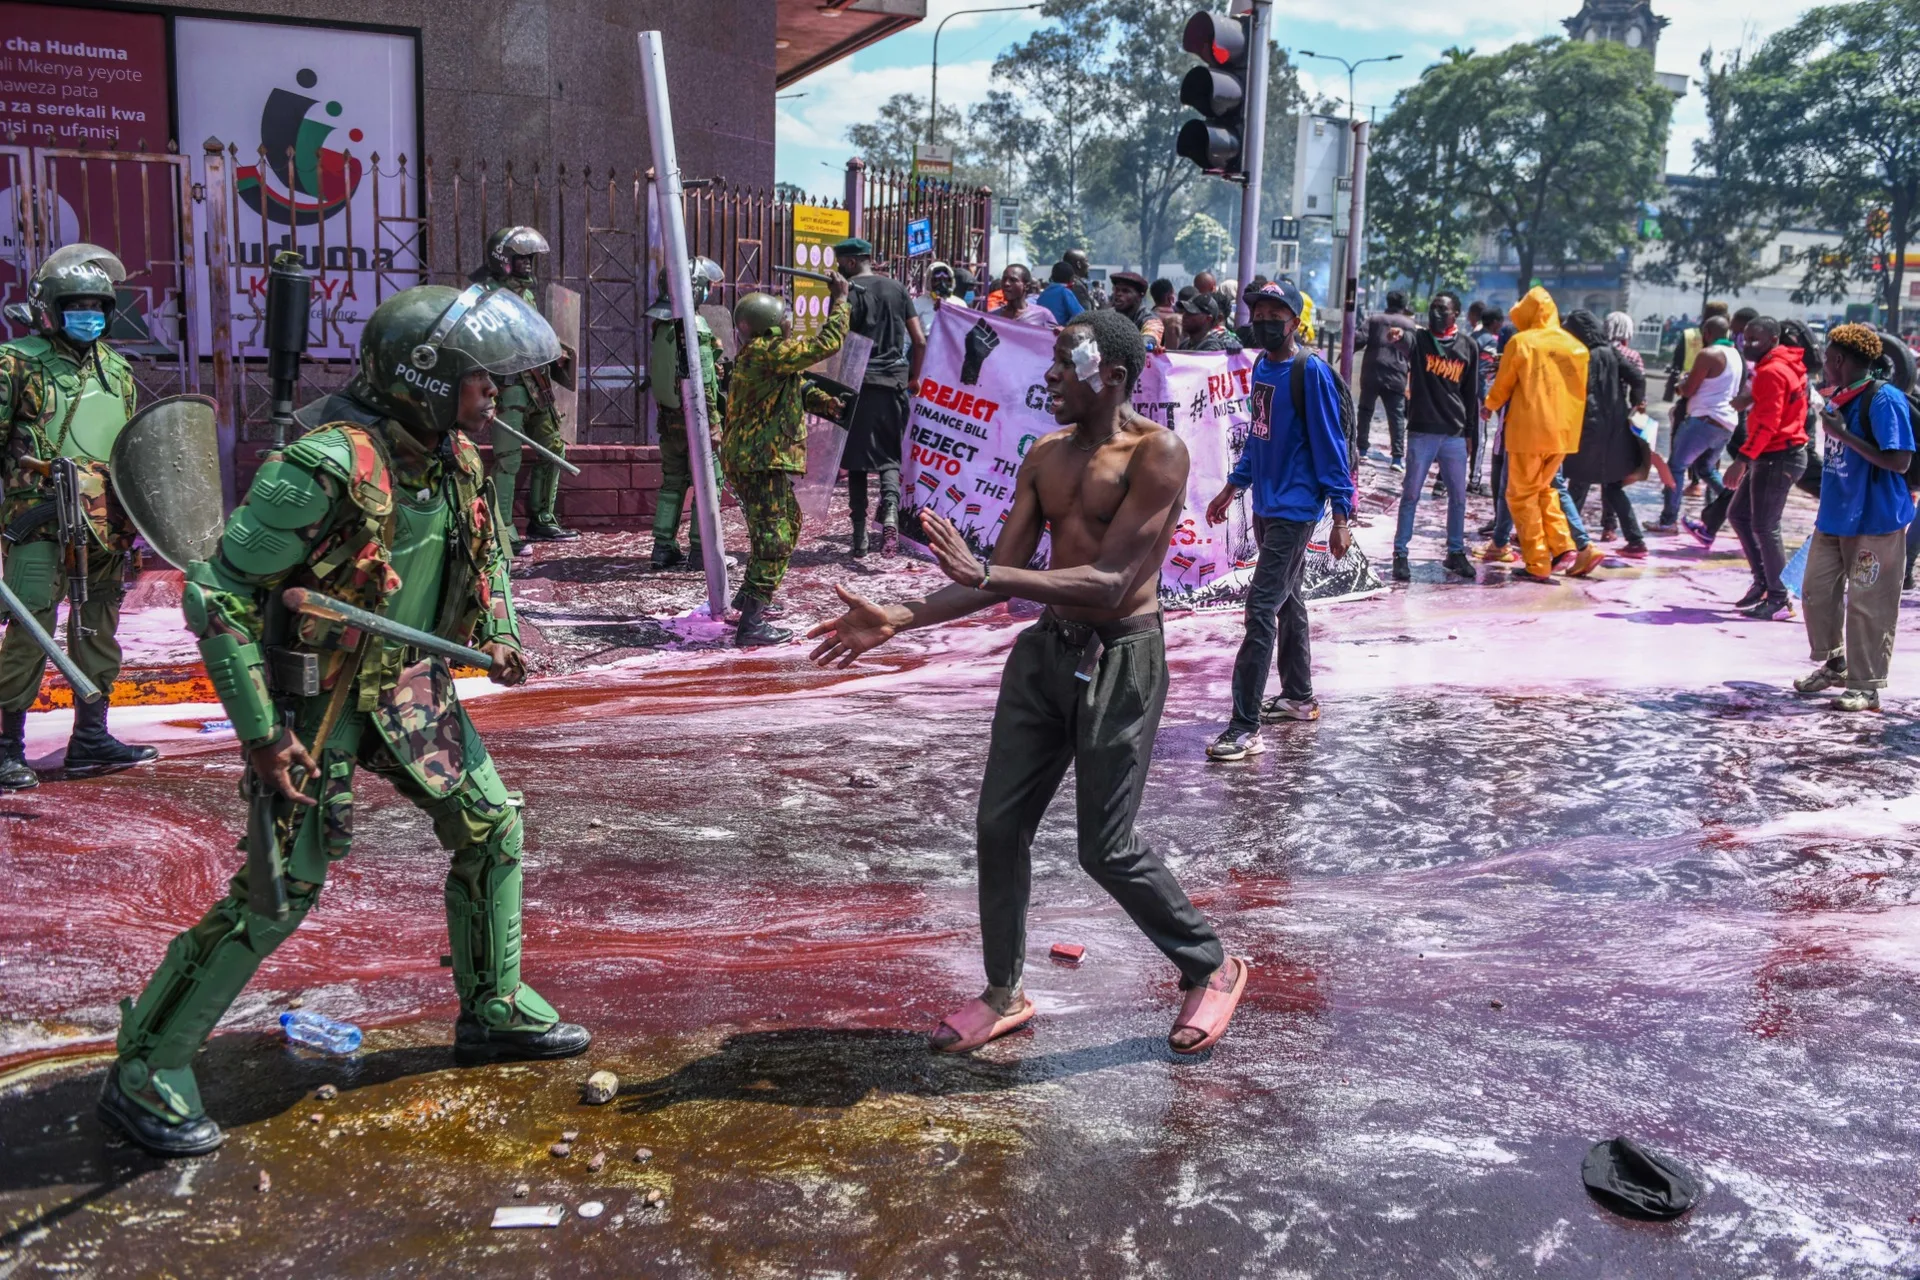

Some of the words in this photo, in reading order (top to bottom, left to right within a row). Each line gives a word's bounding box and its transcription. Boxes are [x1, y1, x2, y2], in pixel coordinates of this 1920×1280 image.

[6, 36, 41, 53] cha
[46, 40, 128, 60] Huduma
[18, 58, 83, 80] Mkenya
[88, 67, 143, 83] yeyote
[62, 84, 99, 99] pata
[11, 101, 31, 113] za
[37, 103, 106, 119] serekali
[112, 106, 146, 122] kwa
[33, 123, 55, 135] na
[60, 123, 120, 140] ufanisi
[918, 164, 950, 174] LOANS
[394, 363, 452, 397] POLICE
[919, 378, 999, 423] REJECT
[1214, 398, 1243, 418] MUST
[914, 403, 962, 431] FINANCE
[964, 422, 988, 440] BILL
[1252, 424, 1268, 437] ATP
[910, 424, 979, 463] REJECT
[910, 444, 961, 476] RUTO
[975, 478, 1008, 501] THE
